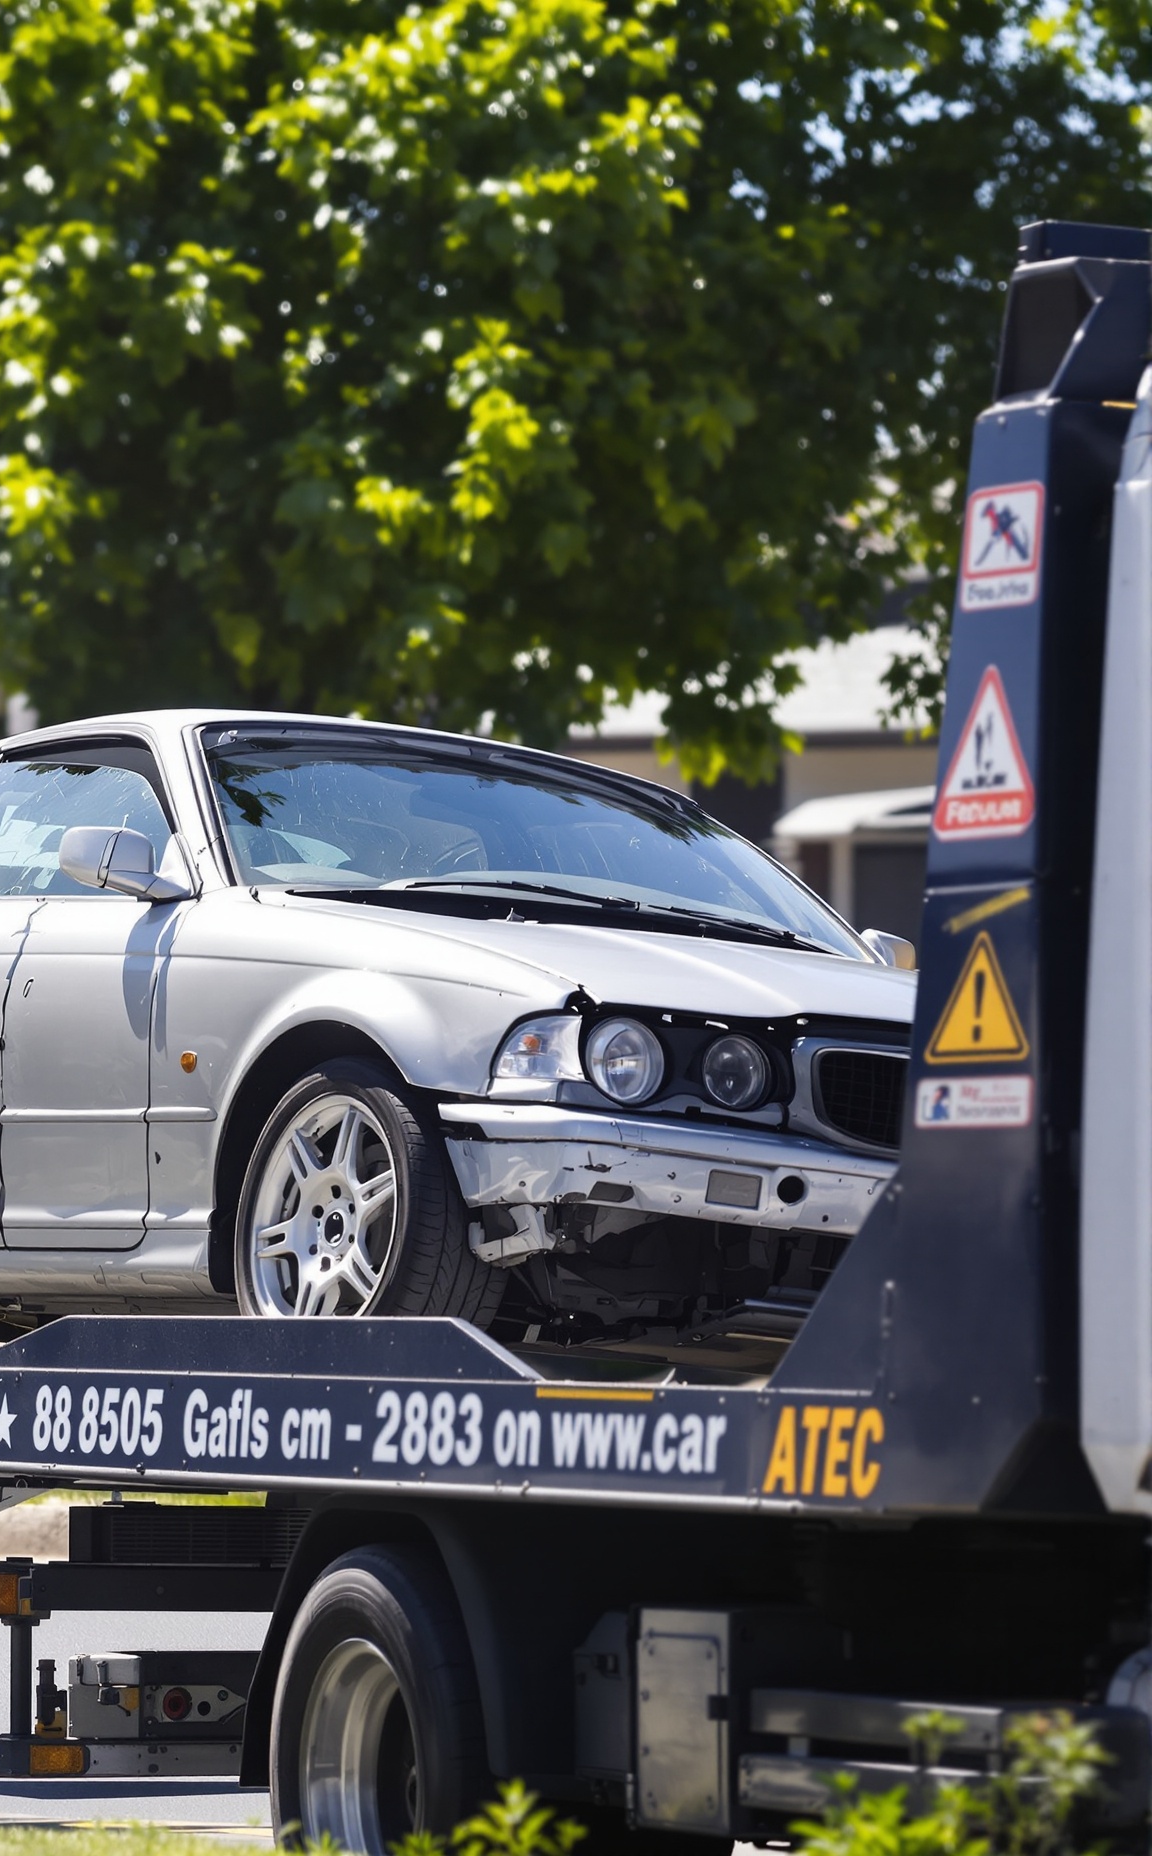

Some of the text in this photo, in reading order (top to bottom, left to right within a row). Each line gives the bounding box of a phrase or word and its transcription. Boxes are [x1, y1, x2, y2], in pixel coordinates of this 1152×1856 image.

[280, 1407, 332, 1461] cm
[371, 1389, 483, 1467] 2883
[492, 1409, 542, 1468] on
[551, 1411, 728, 1474] www.car
[761, 1405, 885, 1500] ATEC
